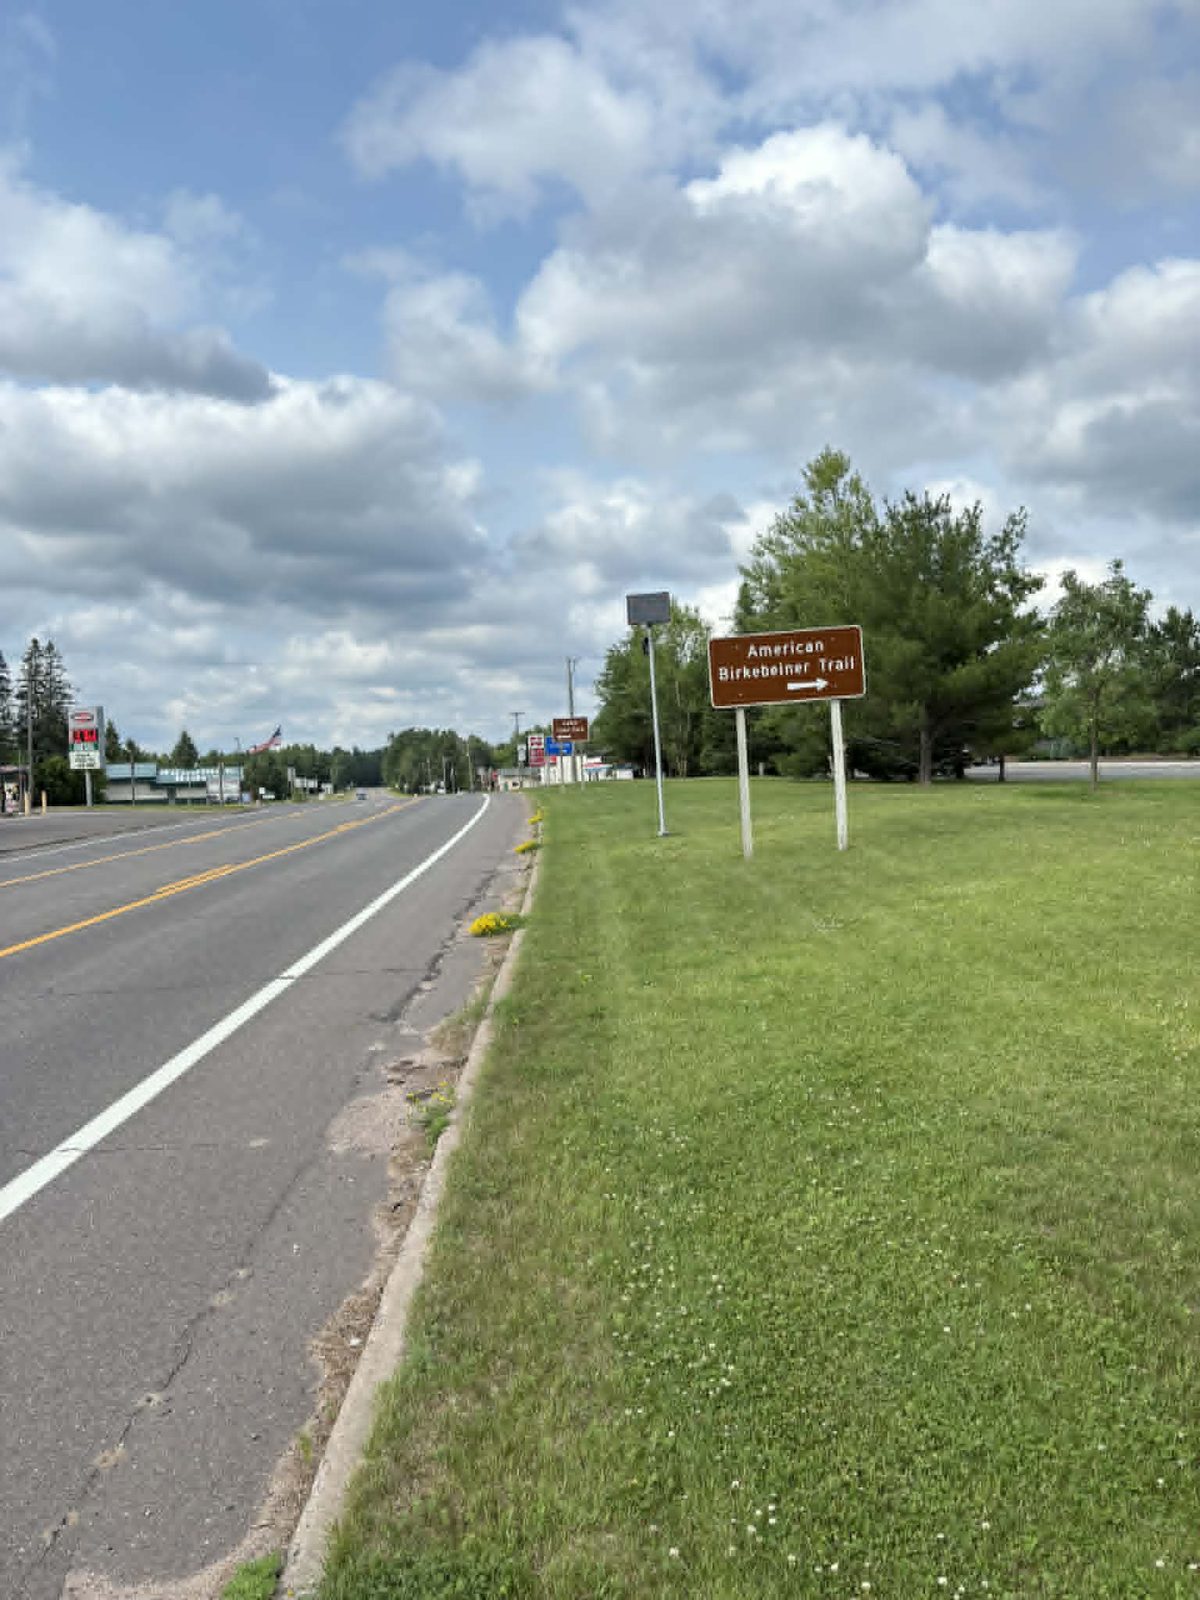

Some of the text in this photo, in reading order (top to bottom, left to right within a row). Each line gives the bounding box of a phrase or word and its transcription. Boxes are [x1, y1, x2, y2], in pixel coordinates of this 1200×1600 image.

[747, 640, 824, 658] American
[718, 656, 855, 681] Birkebeiner Trail
